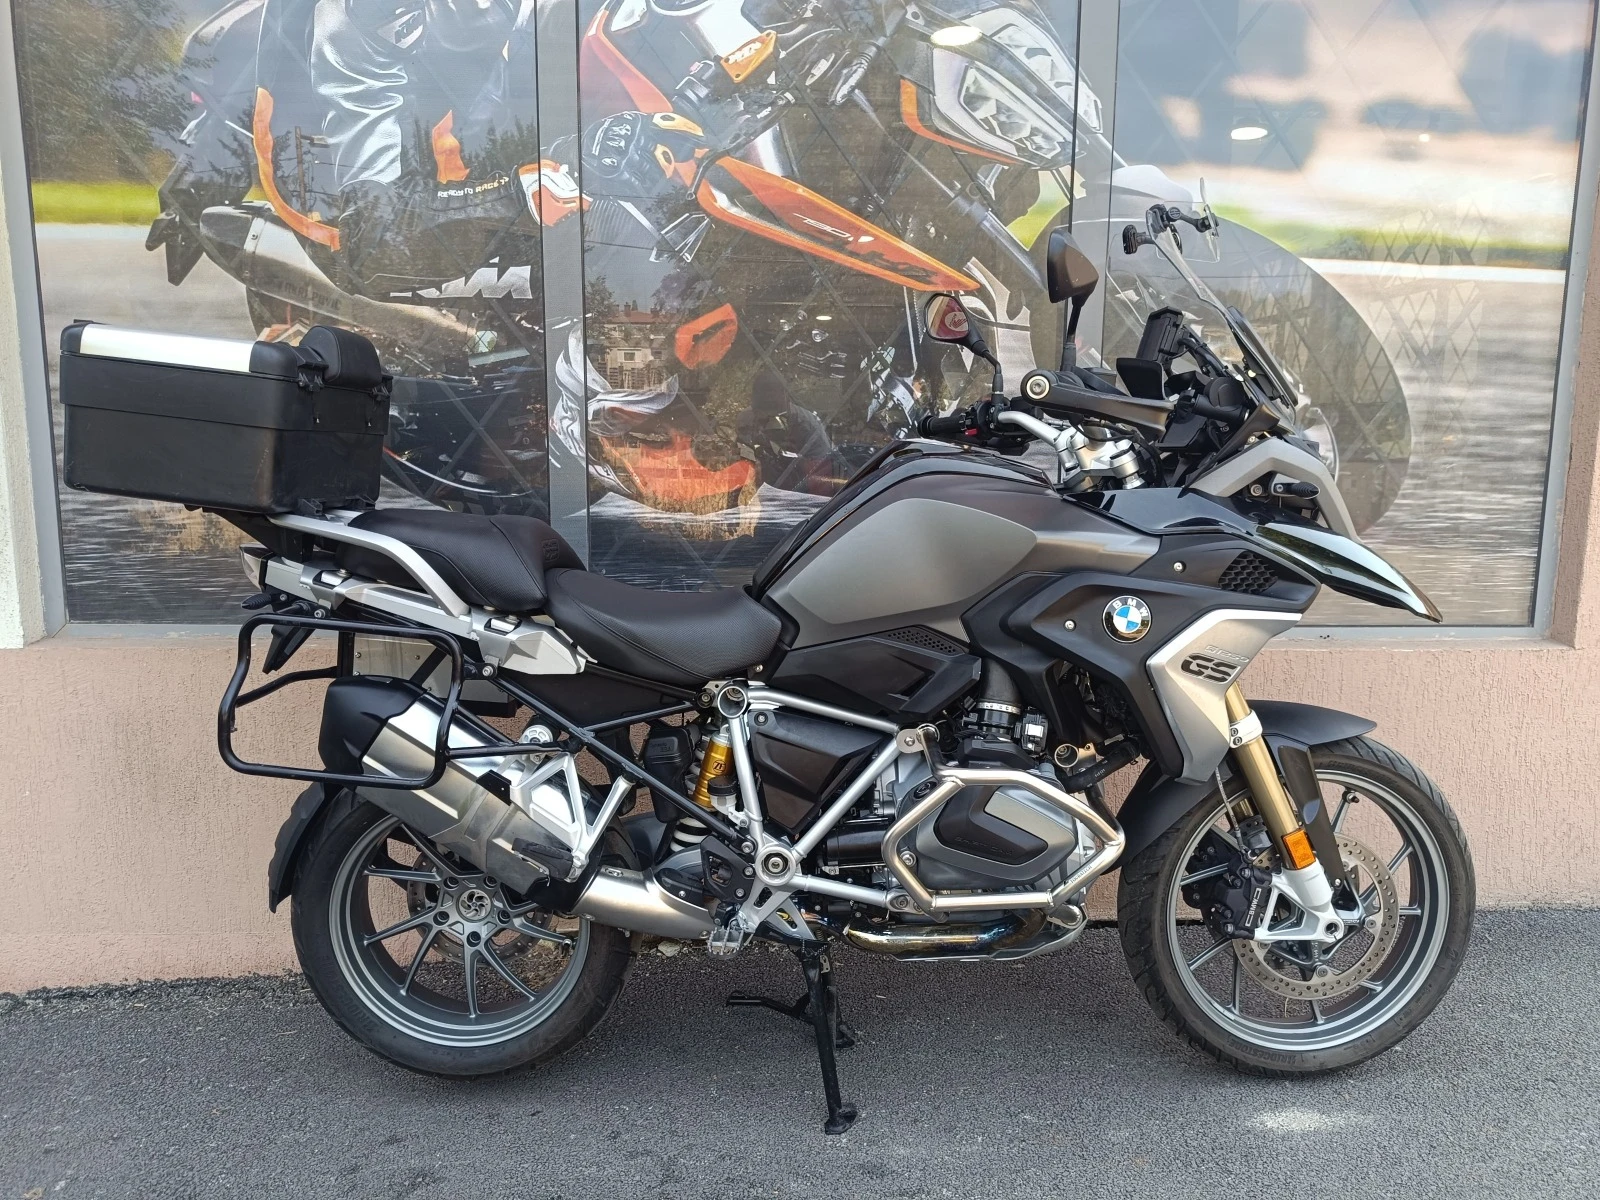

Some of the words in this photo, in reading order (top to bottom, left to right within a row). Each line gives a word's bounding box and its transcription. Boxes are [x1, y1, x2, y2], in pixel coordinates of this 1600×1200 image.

[464, 187, 474, 195] TO
[475, 180, 499, 193] RACE
[1181, 654, 1239, 684] GS
[1249, 897, 1259, 915] BMW
